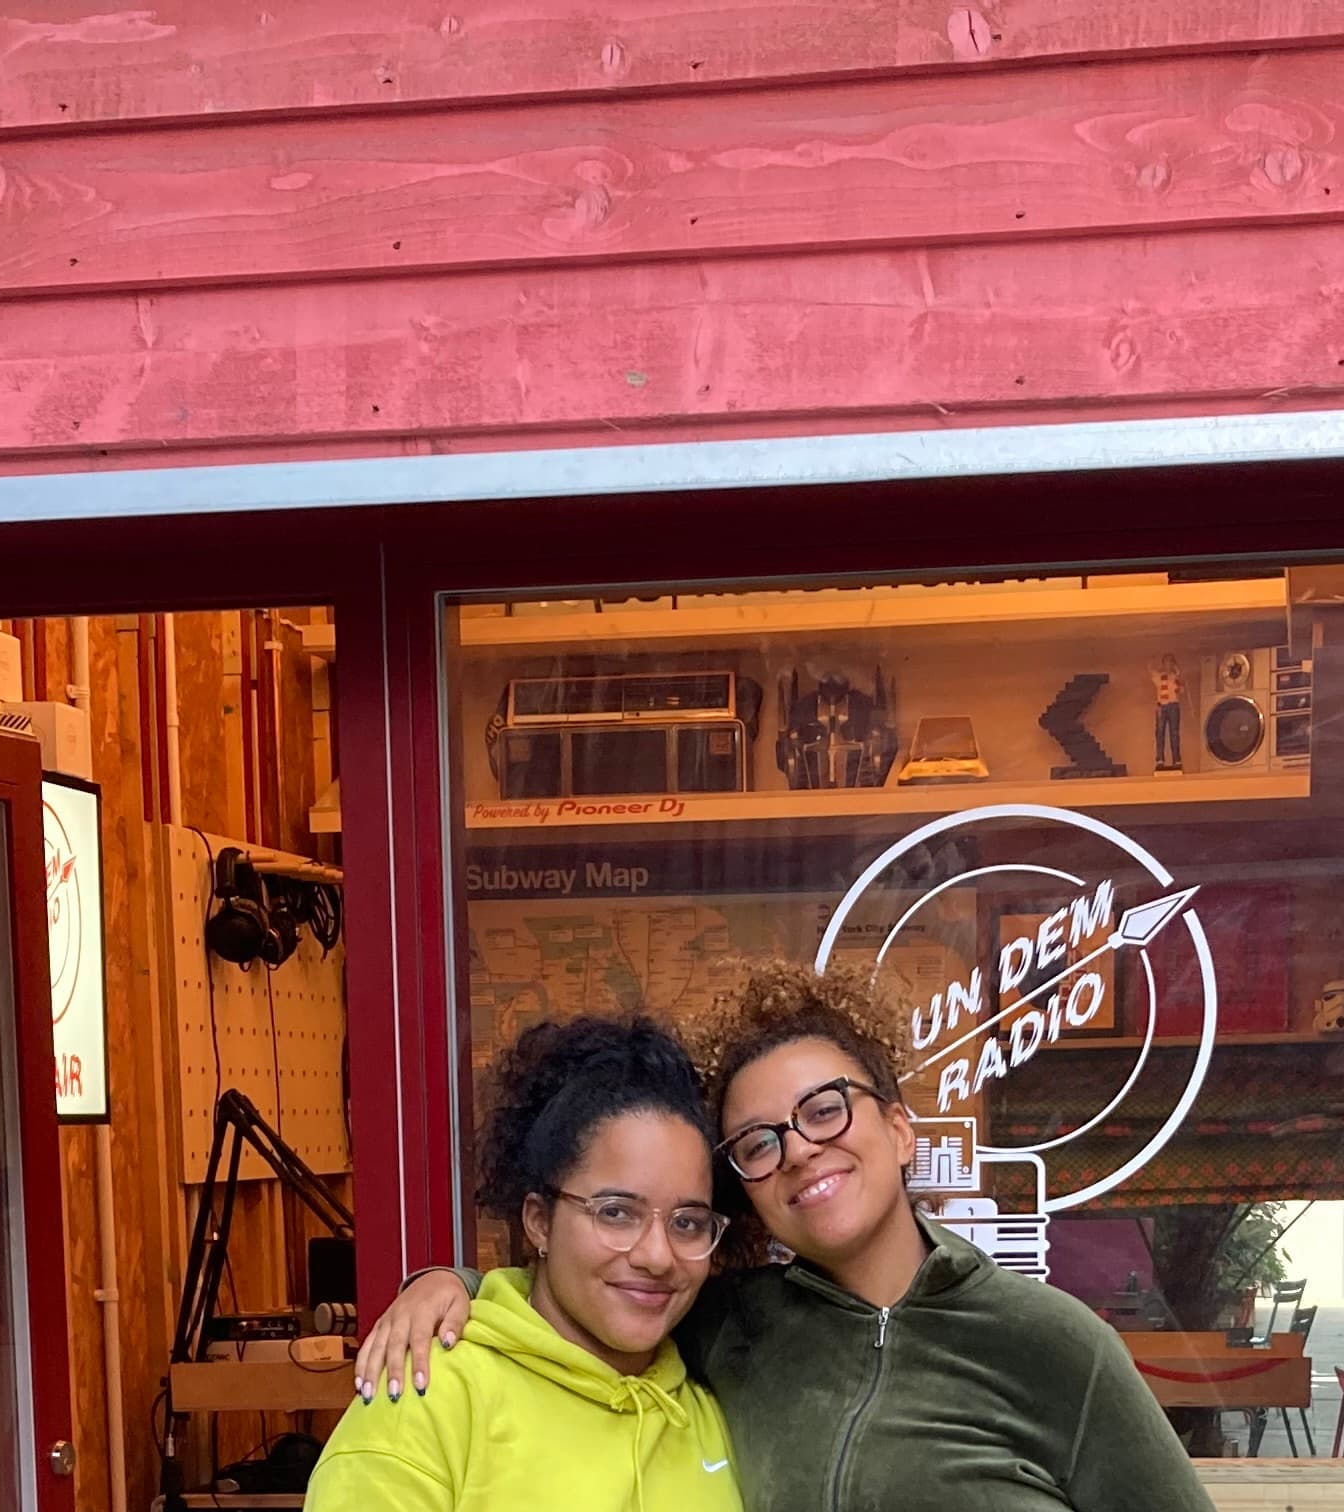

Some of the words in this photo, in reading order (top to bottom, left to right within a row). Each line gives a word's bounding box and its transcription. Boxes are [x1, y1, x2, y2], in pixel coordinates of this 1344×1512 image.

[472, 802, 530, 819] Powered
[533, 802, 550, 823] by
[557, 800, 653, 816] Pioneer
[467, 864, 576, 894] Subway
[585, 862, 649, 893] Map
[912, 966, 983, 1050] UN
[998, 879, 1115, 994] DEM
[937, 972, 1105, 1114] RADIO
